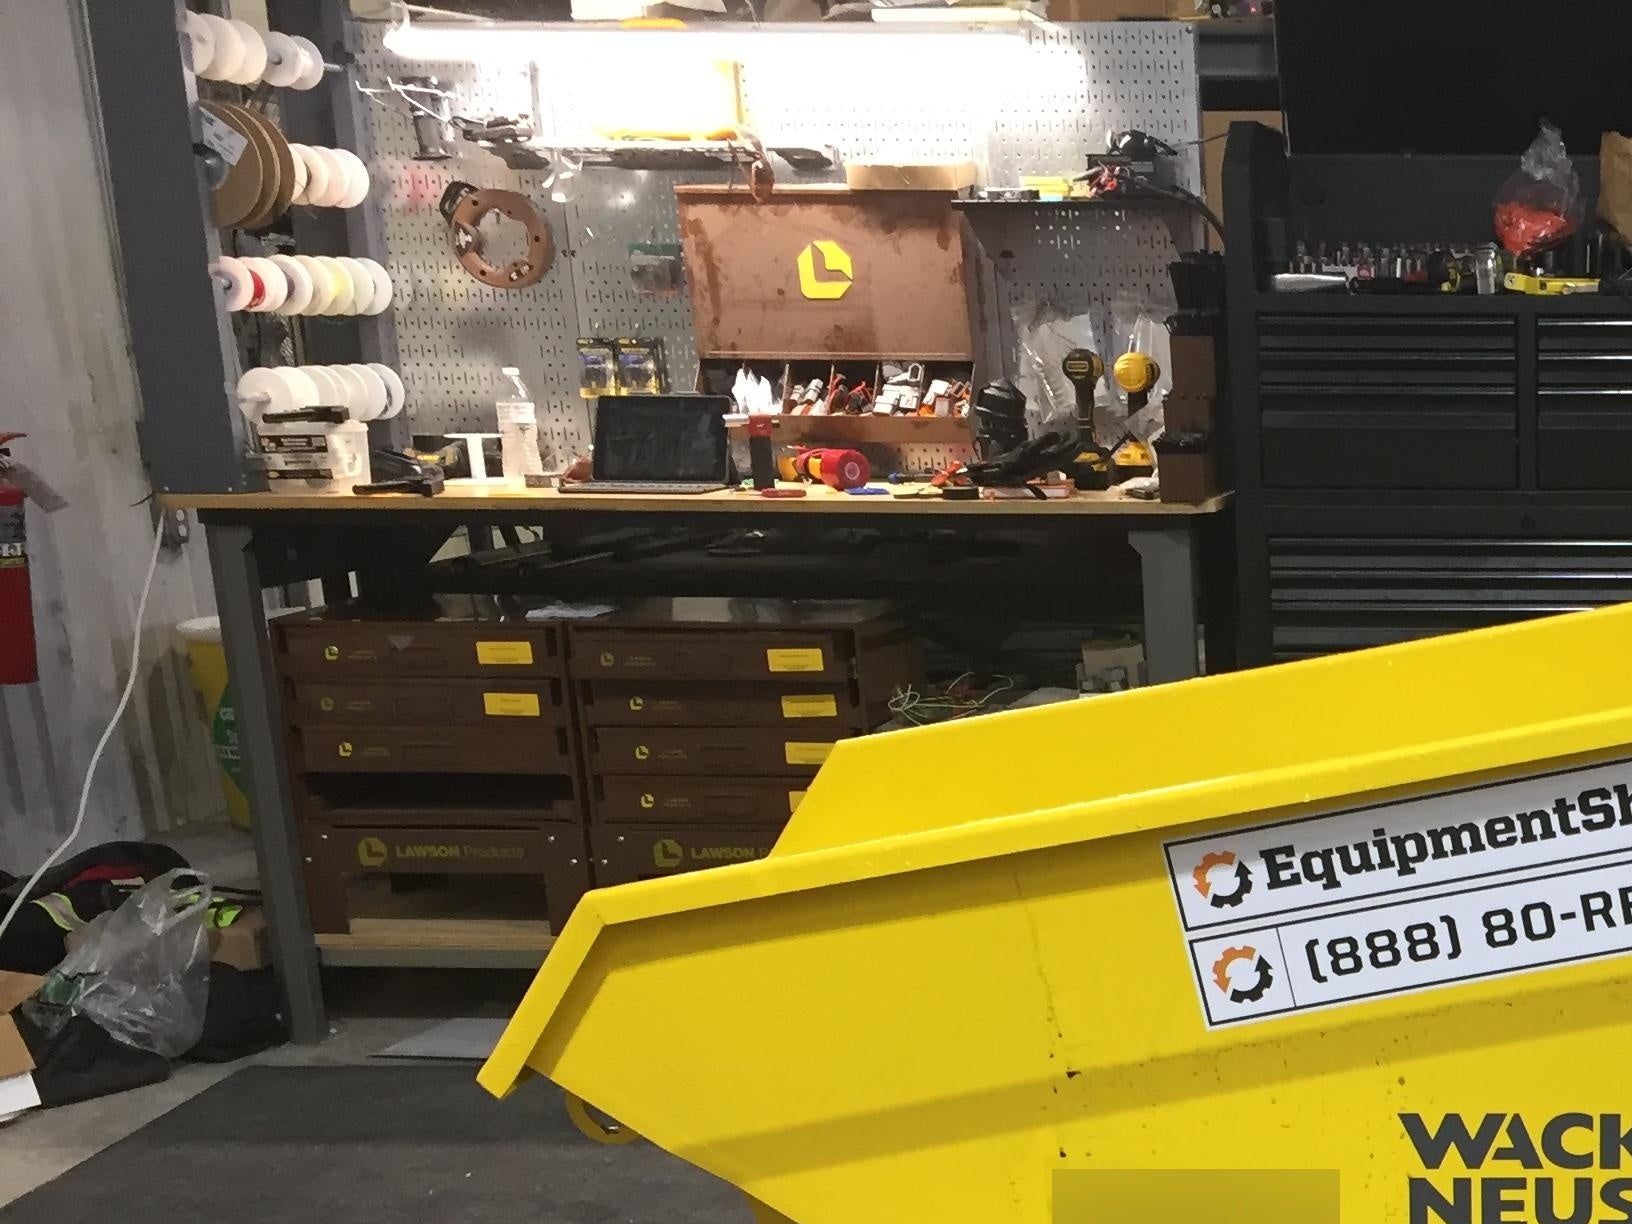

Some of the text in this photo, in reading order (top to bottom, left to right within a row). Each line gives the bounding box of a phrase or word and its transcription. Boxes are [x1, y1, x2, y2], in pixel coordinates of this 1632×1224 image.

[396, 846, 460, 858] LAWSON
[691, 847, 755, 860] LAWSON
[1304, 914, 1463, 984] (888)
